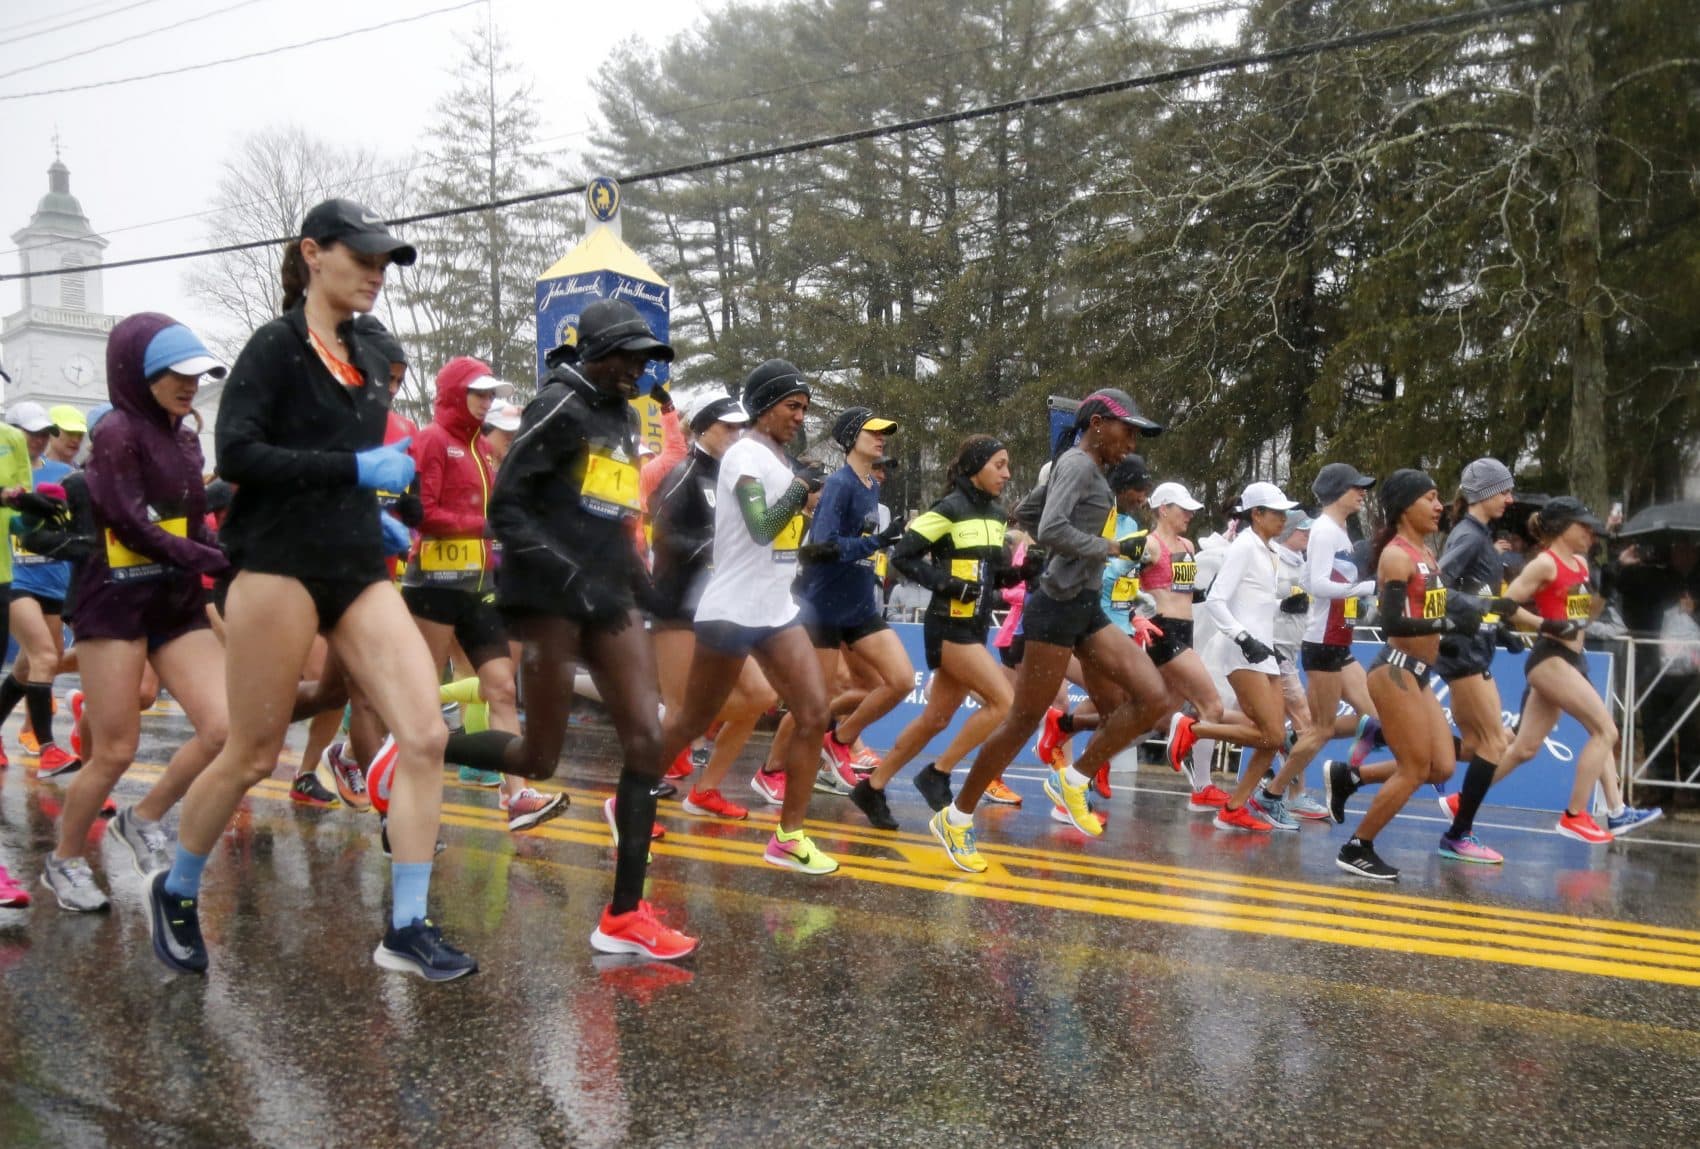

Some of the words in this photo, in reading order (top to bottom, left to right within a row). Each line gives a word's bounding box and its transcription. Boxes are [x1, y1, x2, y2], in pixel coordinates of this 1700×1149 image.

[539, 279, 567, 312] John
[566, 275, 603, 298] Hancock
[609, 278, 634, 300] John
[633, 282, 667, 313] Hancock
[613, 468, 622, 491] 1
[435, 543, 468, 561] 101
